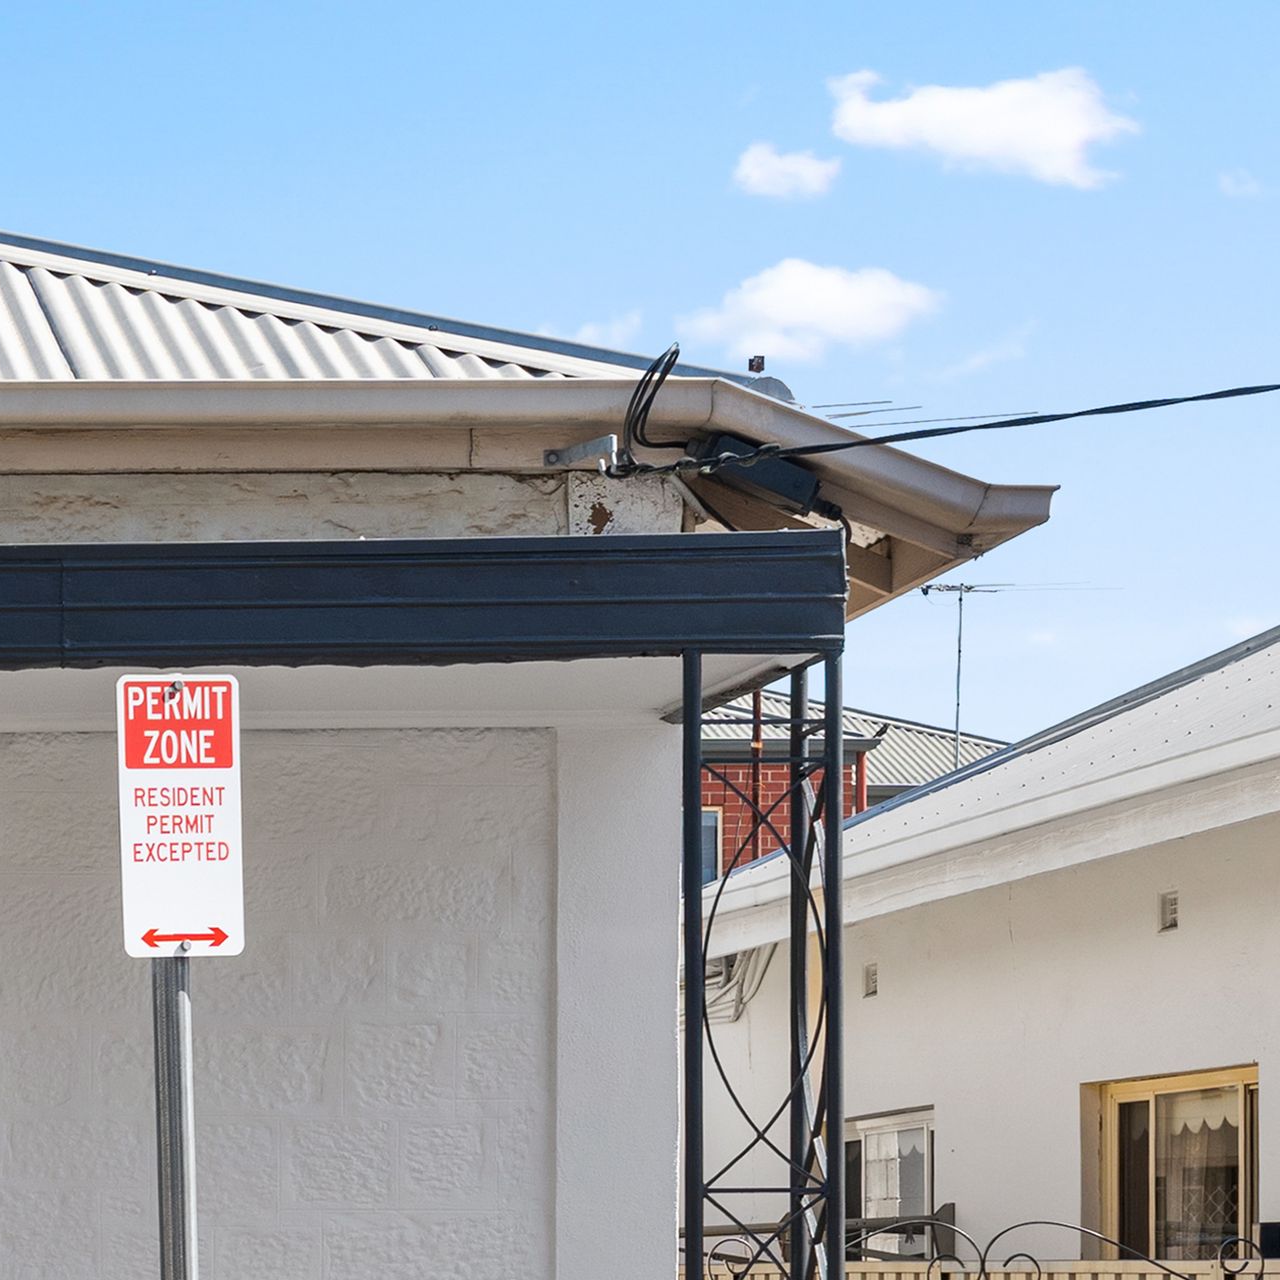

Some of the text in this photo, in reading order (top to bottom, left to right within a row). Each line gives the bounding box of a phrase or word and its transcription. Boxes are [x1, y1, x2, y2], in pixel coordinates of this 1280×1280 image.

[127, 686, 228, 720] PERMIT
[143, 730, 216, 764] ZONE
[134, 786, 225, 807] RESIDENT
[146, 814, 215, 834] PERMIT
[133, 841, 230, 862] EXCEPTED
